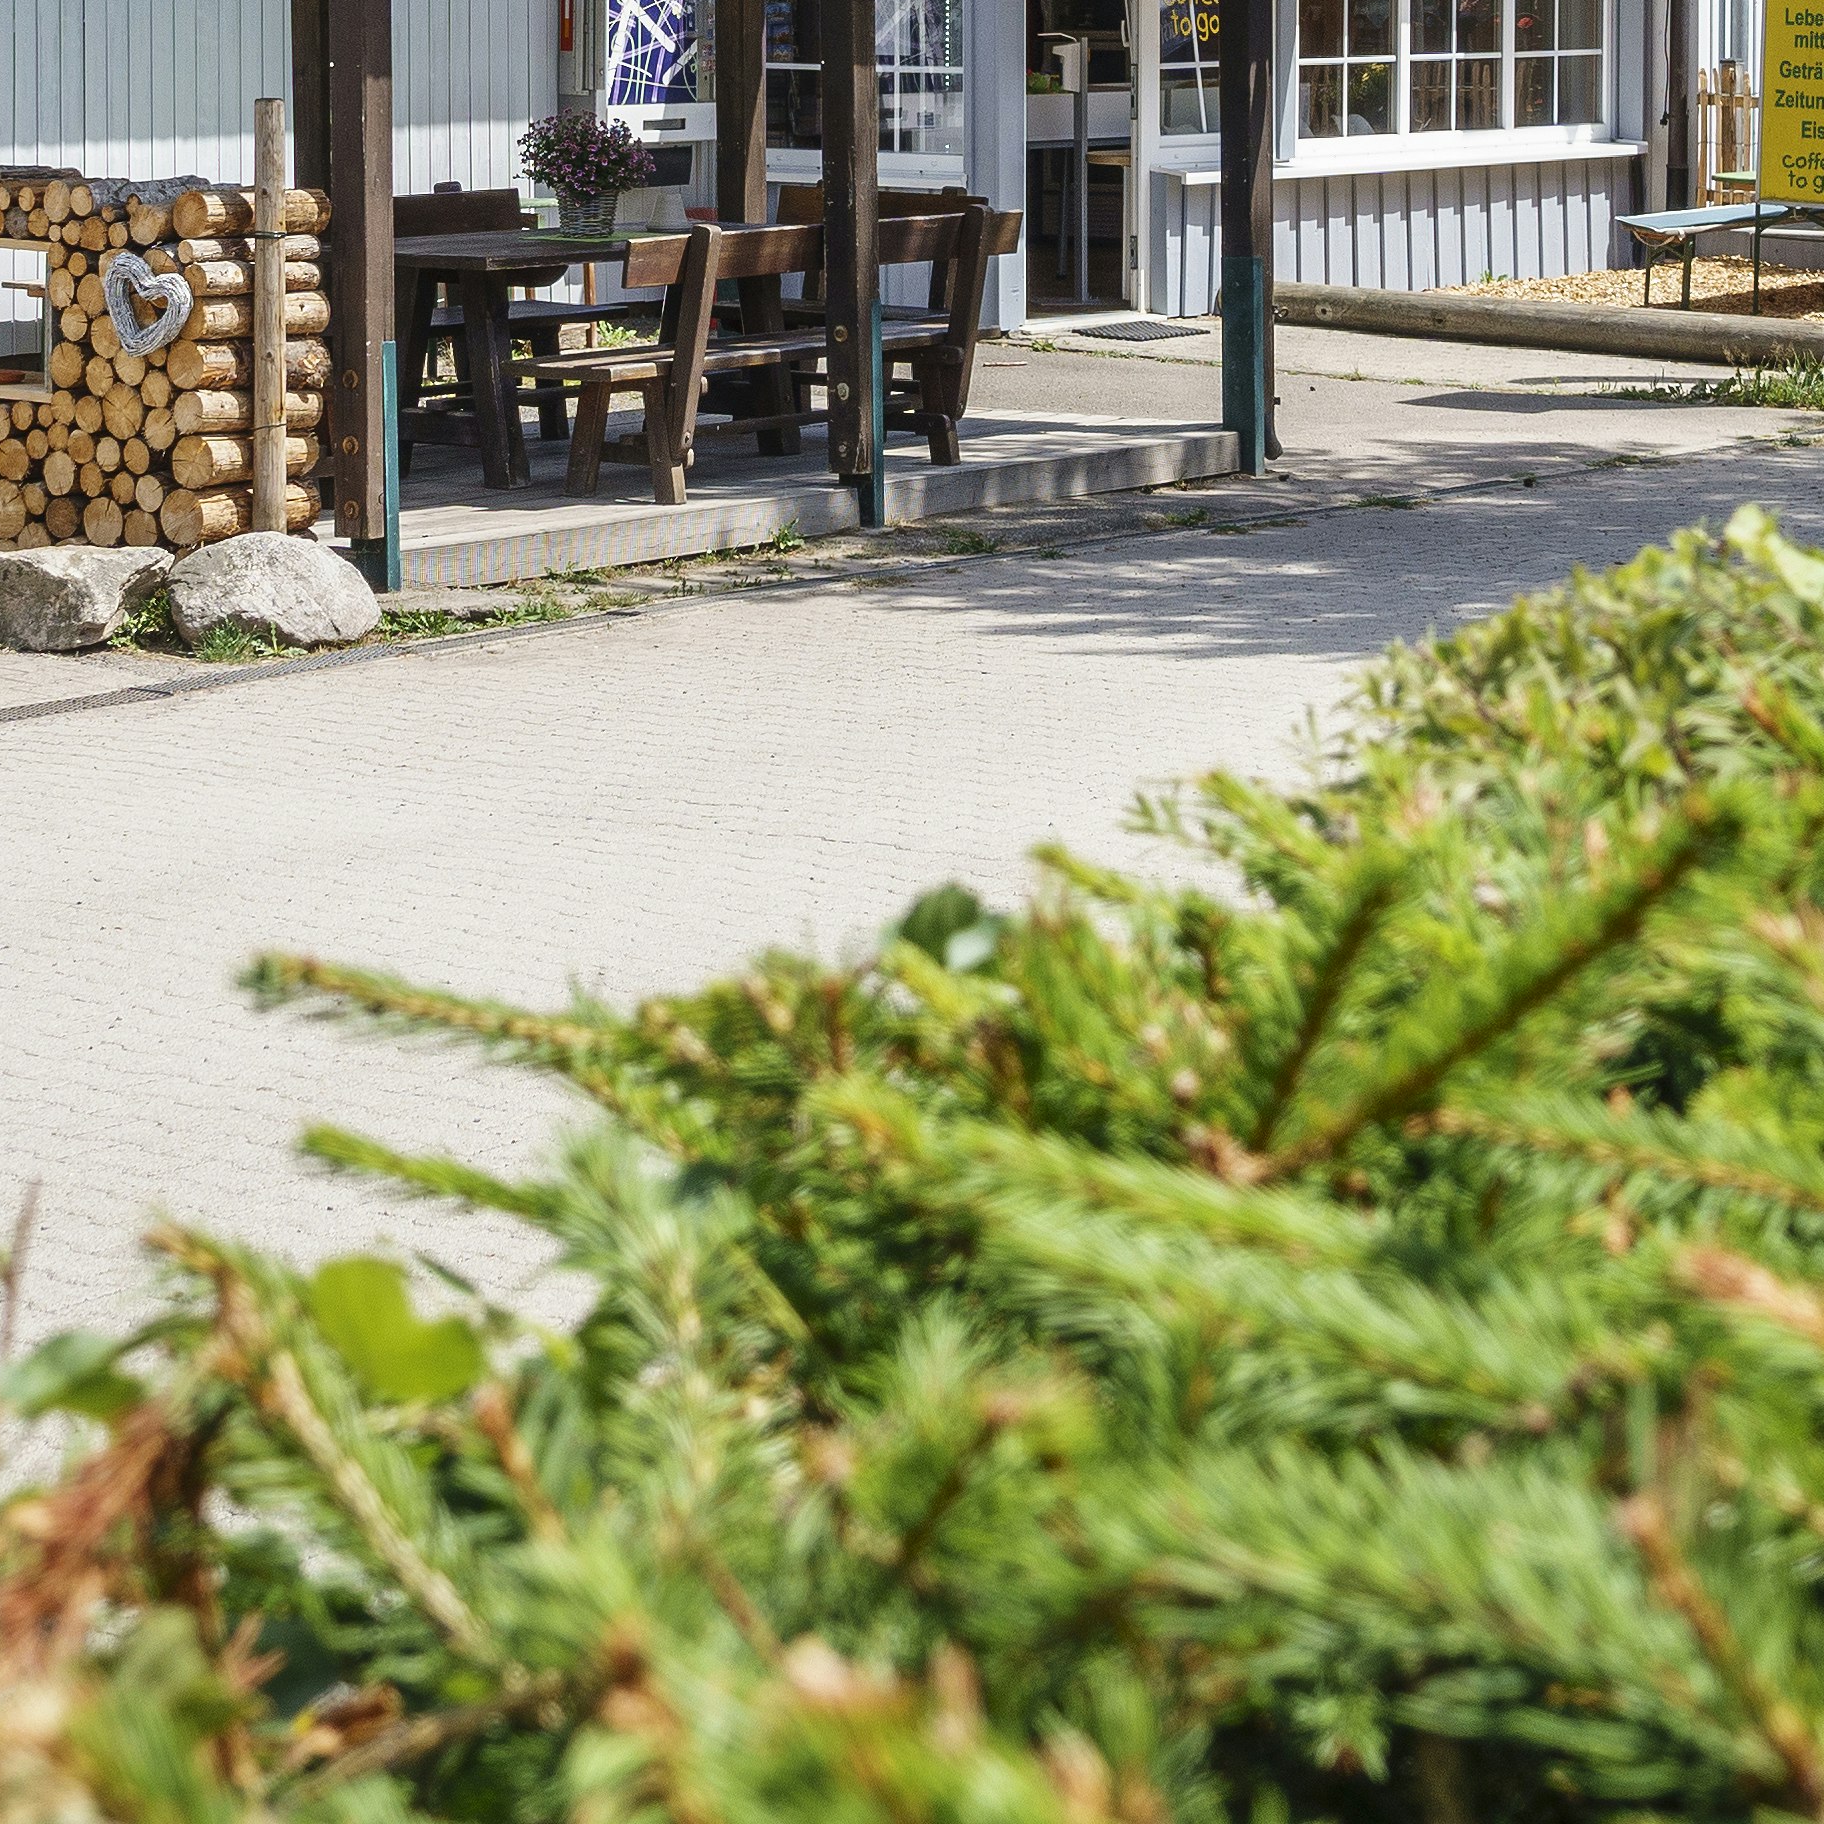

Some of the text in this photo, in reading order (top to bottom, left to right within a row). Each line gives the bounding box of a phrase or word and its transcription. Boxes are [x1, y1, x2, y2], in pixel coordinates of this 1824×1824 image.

[1170, 9, 1220, 42] to go
[1788, 170, 1808, 189] to
